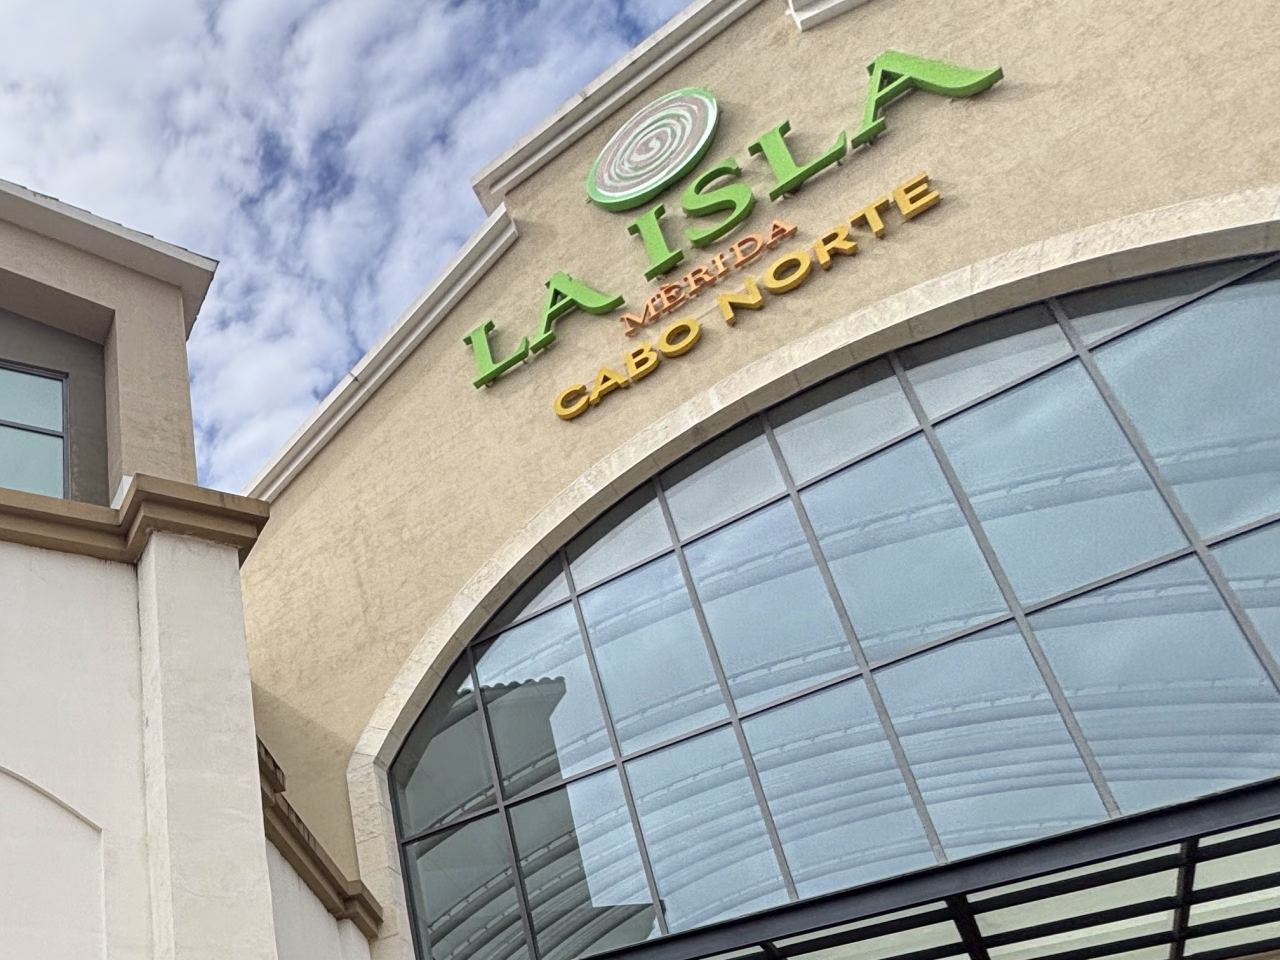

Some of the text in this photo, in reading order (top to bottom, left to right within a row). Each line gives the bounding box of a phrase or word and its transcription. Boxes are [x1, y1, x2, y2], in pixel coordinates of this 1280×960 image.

[463, 49, 1004, 390] LA ISLA
[554, 172, 942, 421] CABO NORTE
